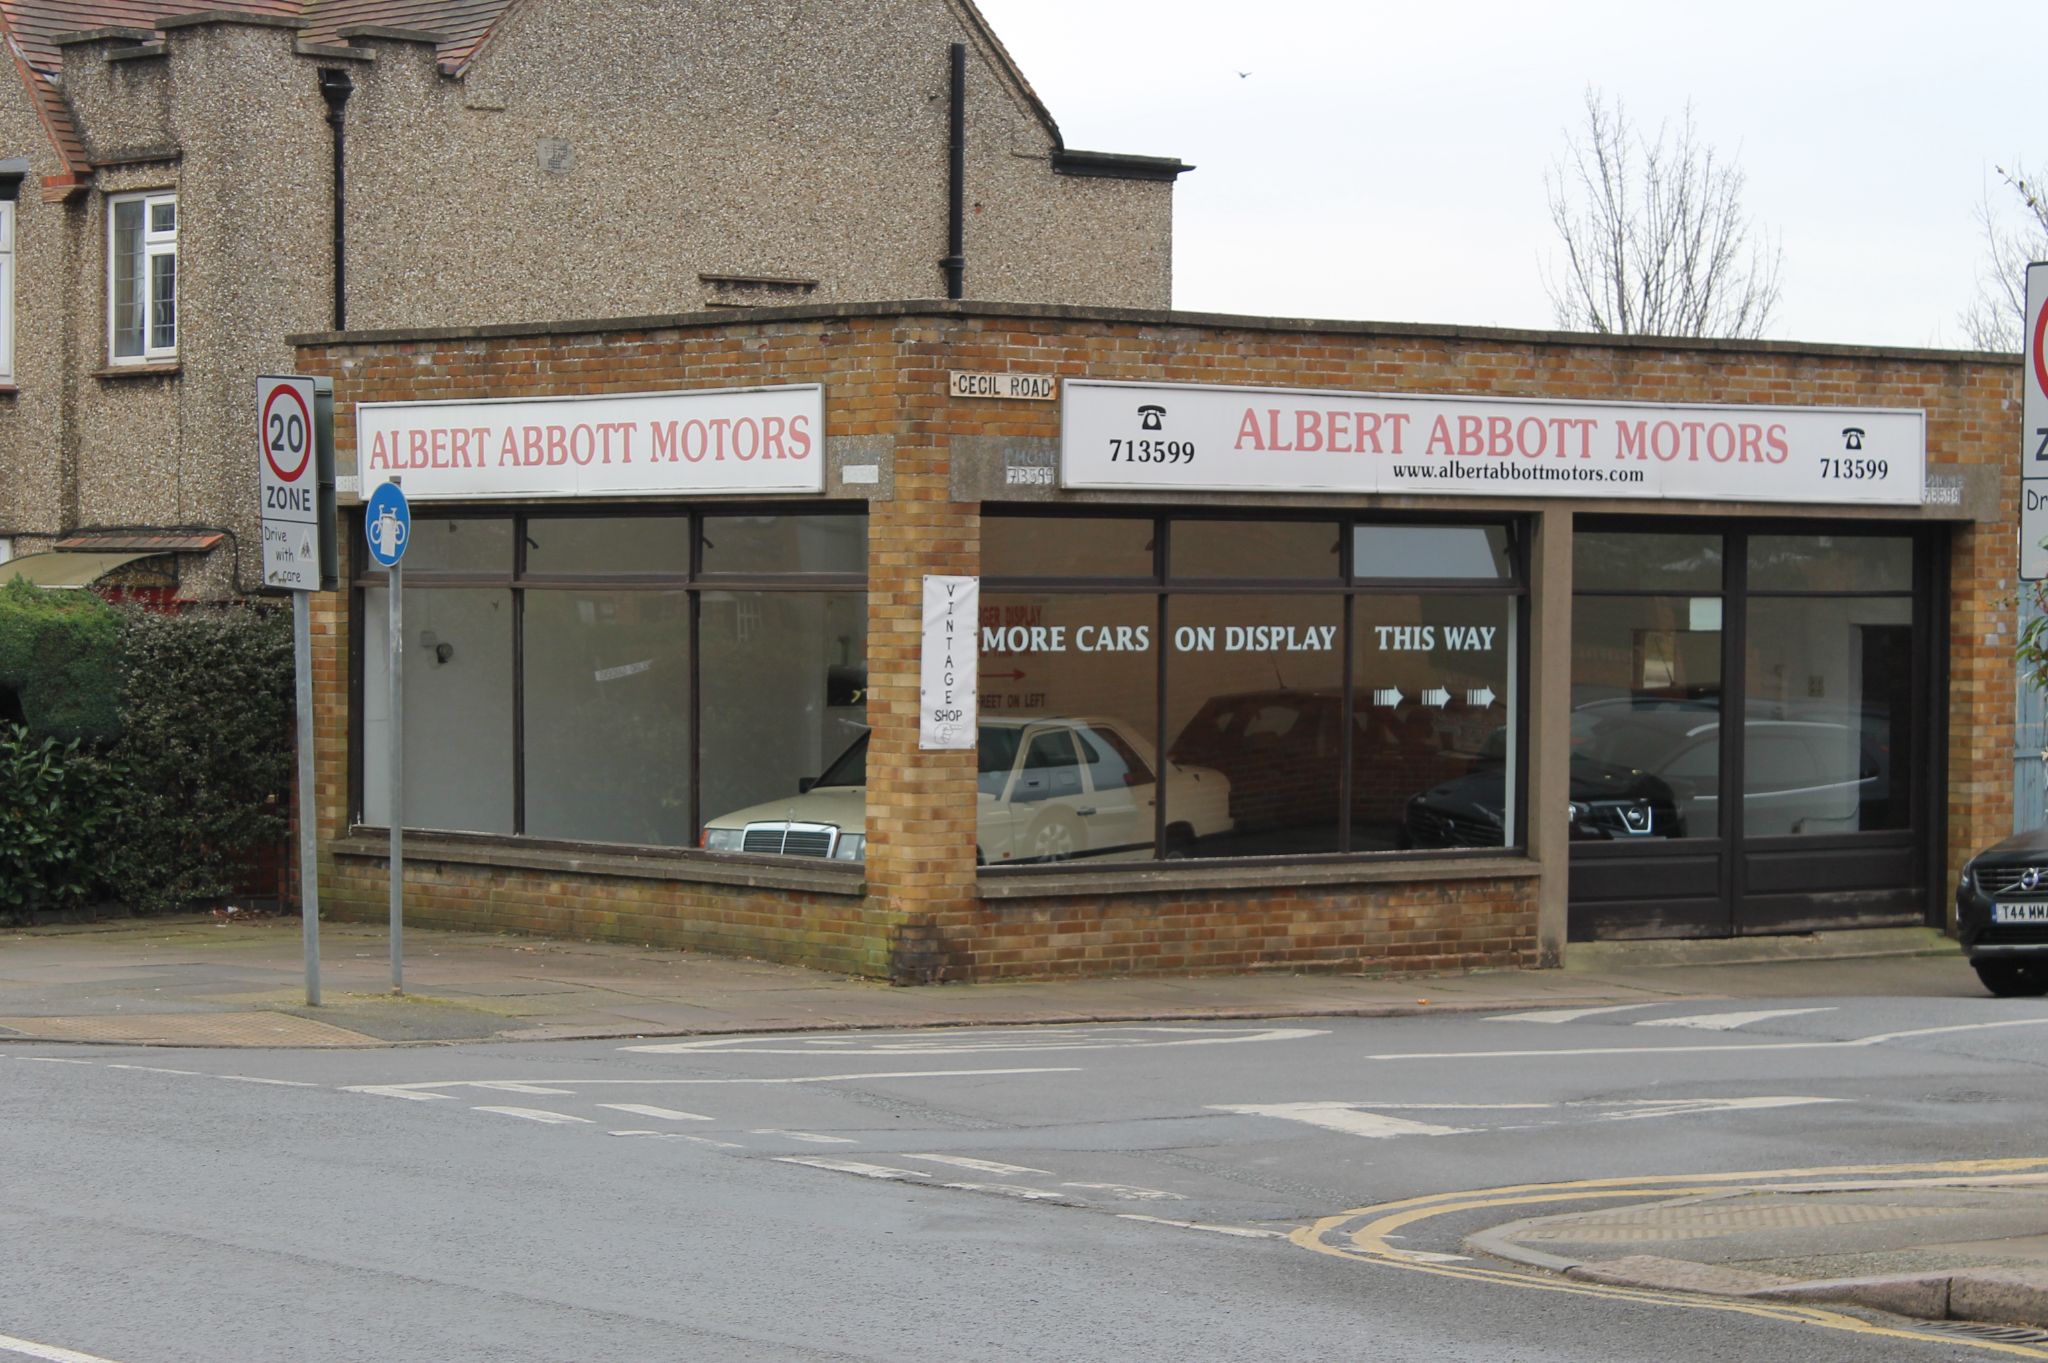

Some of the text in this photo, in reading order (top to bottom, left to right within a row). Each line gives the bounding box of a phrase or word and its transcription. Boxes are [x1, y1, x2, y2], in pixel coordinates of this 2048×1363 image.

[958, 375, 1050, 397] CECIL ROAD
[269, 412, 304, 453] 20
[370, 415, 812, 470] ALBERT ABBOTT MOTORS
[1234, 408, 1790, 465] ALBERT ABBOTT MOTORS
[1109, 439, 1195, 464] 713599
[1393, 460, 1645, 482] www.albertabbottmotors.com
[1820, 458, 1888, 480] 713599
[266, 485, 311, 512] ZONE
[264, 525, 287, 543] Drive
[275, 547, 294, 562] with
[982, 625, 1497, 652] MORE CARS ON DISPLAY THIS WAY
[1025, 693, 1046, 708] LEFT
[934, 709, 963, 722] SHOP
[2003, 905, 2026, 919] T44
